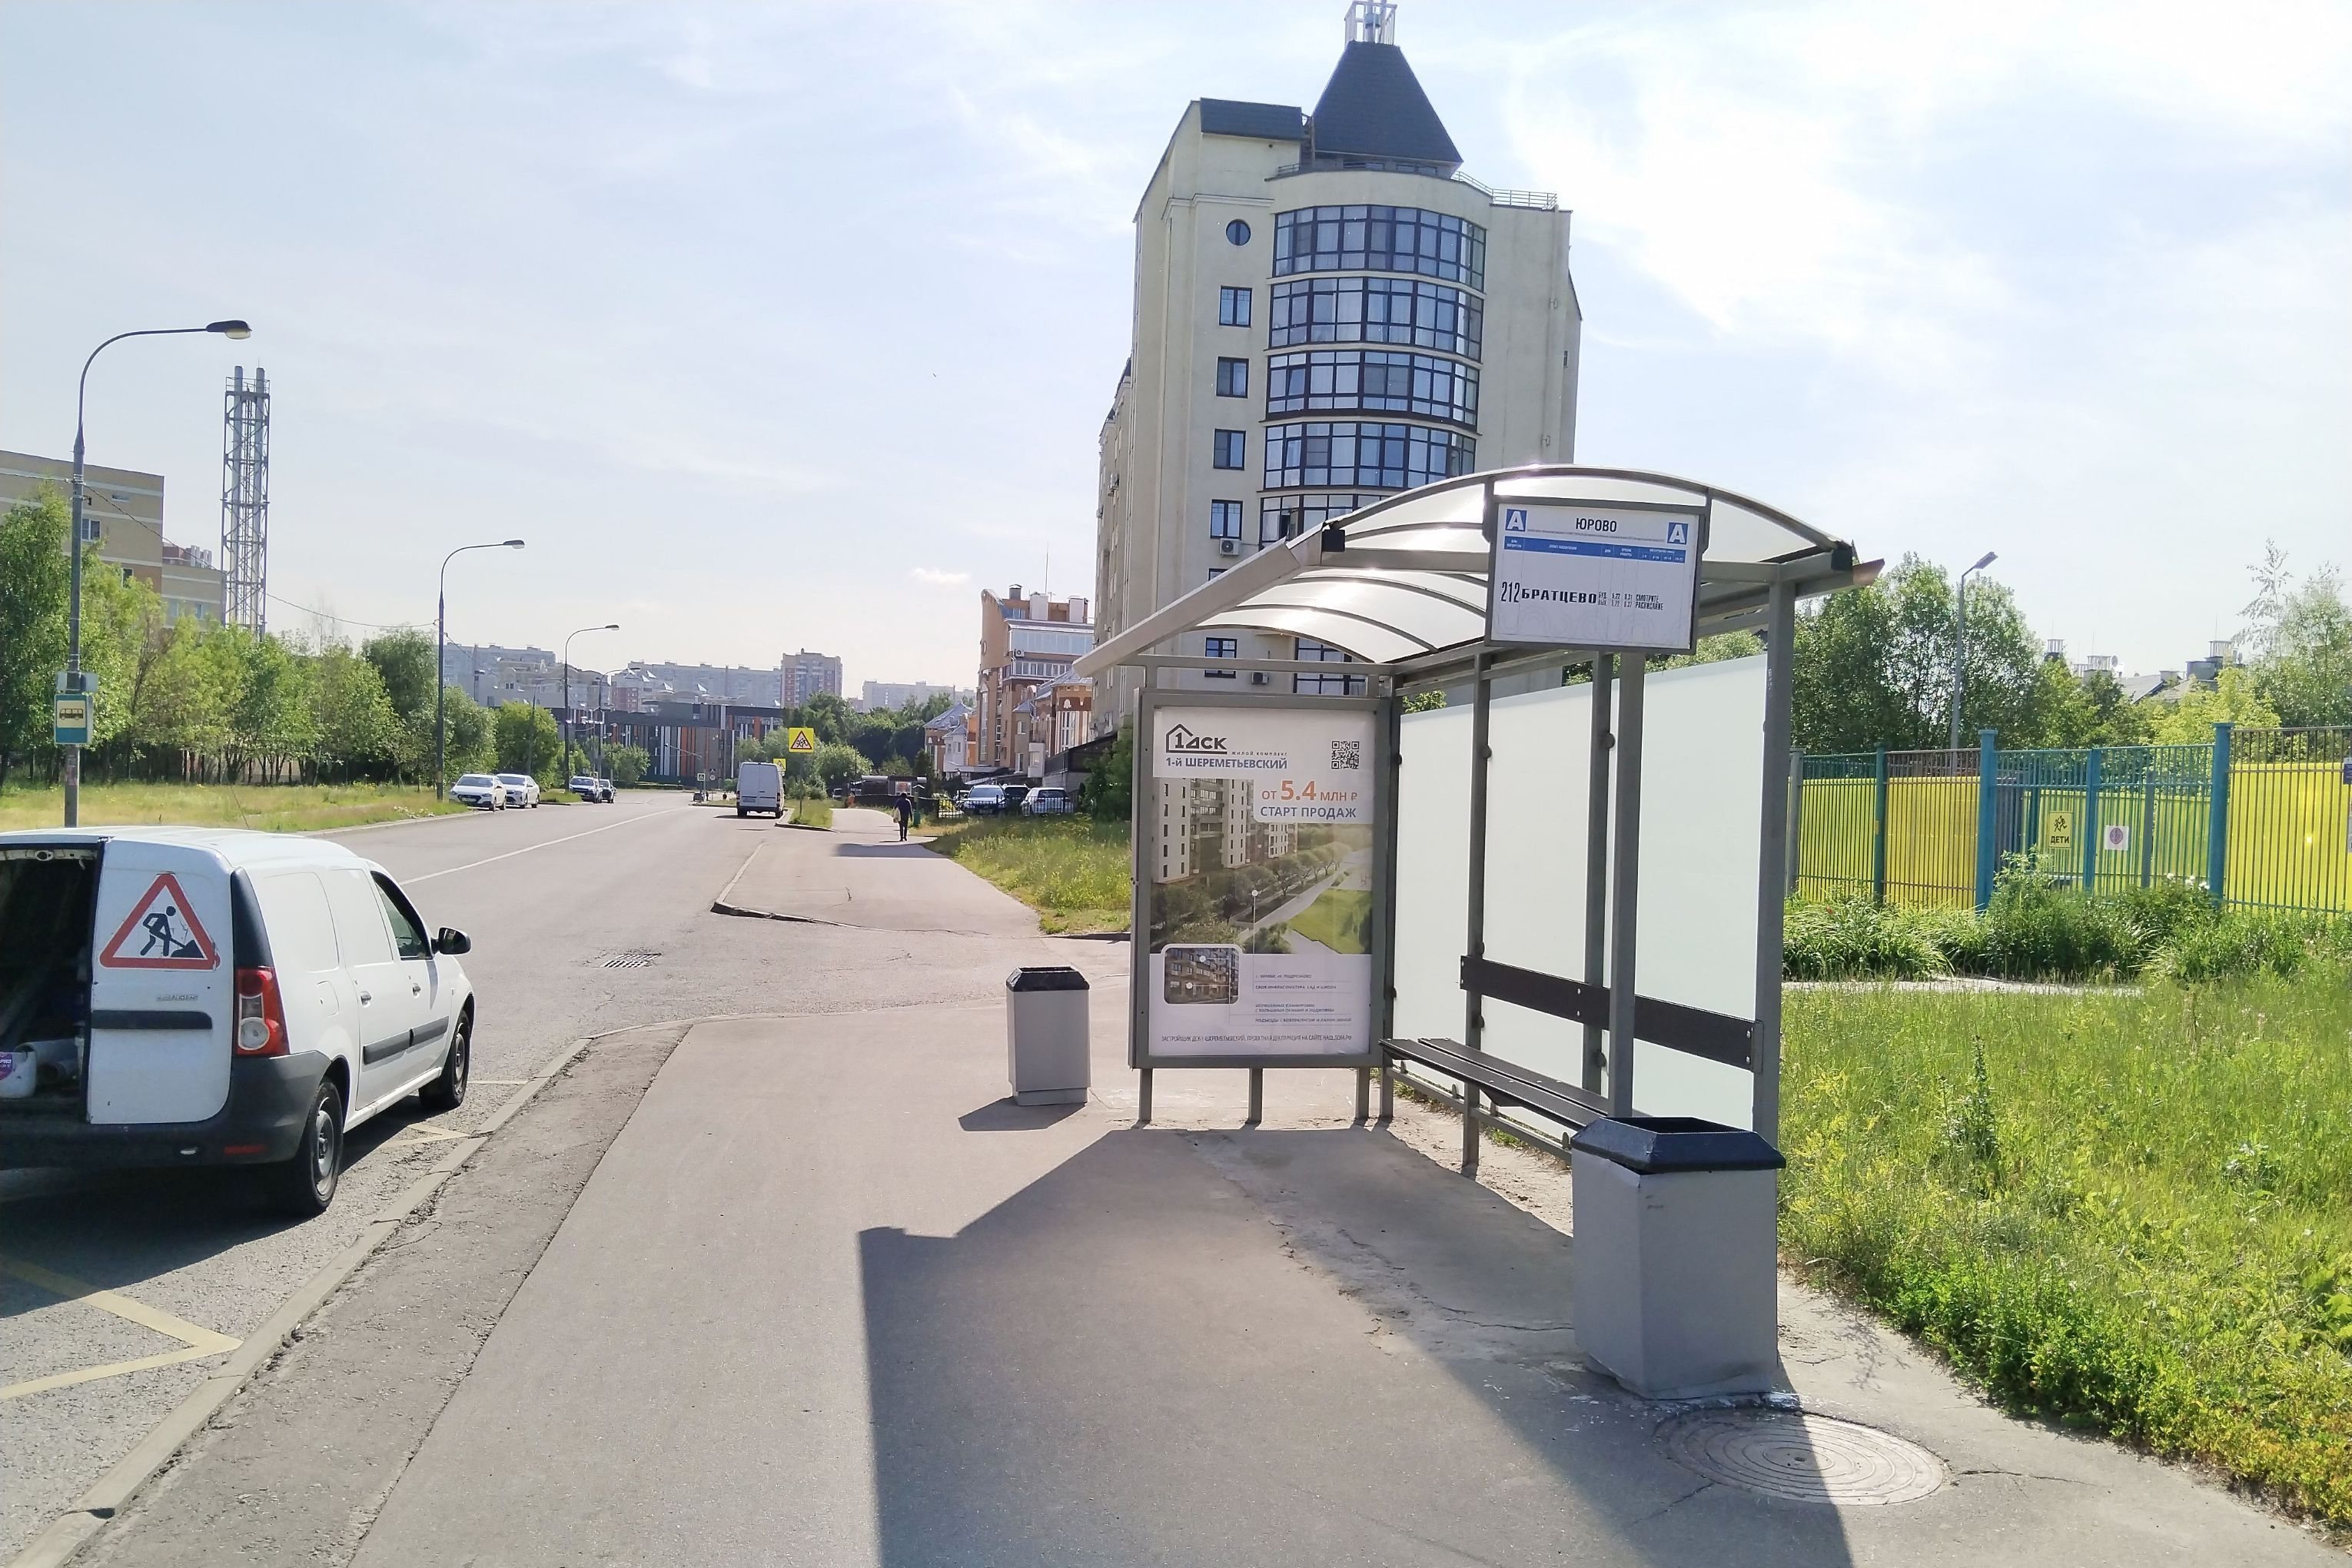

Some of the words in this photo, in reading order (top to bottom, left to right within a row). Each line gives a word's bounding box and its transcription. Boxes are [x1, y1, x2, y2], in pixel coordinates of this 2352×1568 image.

[1576, 517, 1617, 533] ЮРОВО
[1500, 581, 1520, 603] 212
[1521, 588, 1597, 604] БРАТЦЕВО
[1166, 757, 1182, 767] 1-й
[1185, 757, 1287, 769] ШЕРЕМЕТЬЕВСКИЙ
[1261, 790, 1277, 800] ОТ
[1281, 780, 1317, 801] 5.4
[1320, 791, 1347, 801] МЛН
[1260, 806, 1297, 817] СТАРТ
[1301, 807, 1357, 820] ПРОДАЖ
[2050, 835, 2069, 845] ДЕТИ
